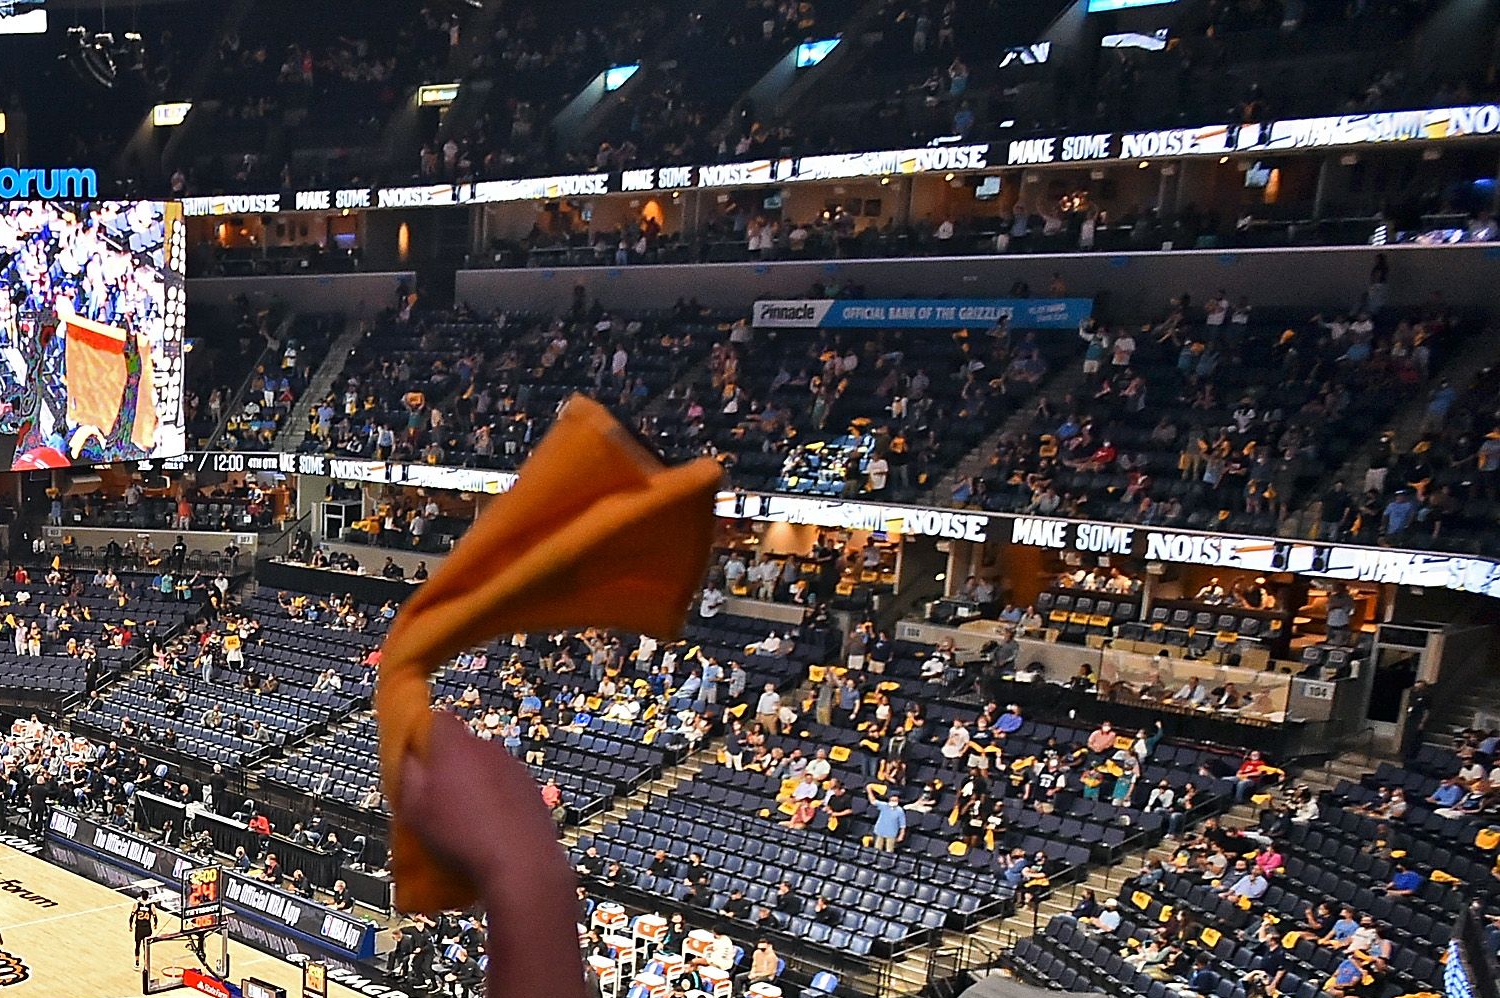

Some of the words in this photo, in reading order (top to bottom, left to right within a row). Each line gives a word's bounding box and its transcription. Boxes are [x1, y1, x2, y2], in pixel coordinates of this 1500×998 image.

[919, 143, 989, 171] NOISE
[1008, 138, 1055, 164] MAKE
[1062, 134, 1109, 160] SOME
[1120, 128, 1199, 158] NOISE
[557, 174, 608, 196] NOISE
[622, 168, 654, 190] MAKE
[659, 166, 691, 187] SOME
[698, 163, 752, 188] NOISE
[224, 194, 280, 214] NOISE
[296, 191, 331, 210] MAKE
[336, 189, 370, 208] SOME
[378, 187, 434, 208] NOISE
[759, 303, 815, 320] Pinnacle
[842, 307, 886, 320] OFFICIAL
[888, 306, 917, 320] BANK
[919, 306, 933, 320] OF
[936, 306, 956, 320] THE
[213, 454, 243, 472] 12:00
[299, 456, 325, 476] SOME
[330, 459, 372, 480] NOISE
[904, 509, 988, 543] NOISE
[1012, 517, 1067, 548] MAKE
[1076, 525, 1133, 555] SOME
[1145, 532, 1242, 567] NOISE
[1309, 686, 1327, 697] 104
[93, 827, 107, 847] The
[106, 831, 128, 858] Official
[128, 840, 143, 863] NBA
[142, 845, 156, 870] App
[190, 883, 215, 906] 24
[225, 878, 239, 901] The
[238, 881, 267, 913] Official
[267, 892, 285, 918] NBA
[284, 899, 300, 927] App
[137, 911, 150, 921] 24
[331, 917, 347, 941] NBA
[346, 925, 361, 949] App
